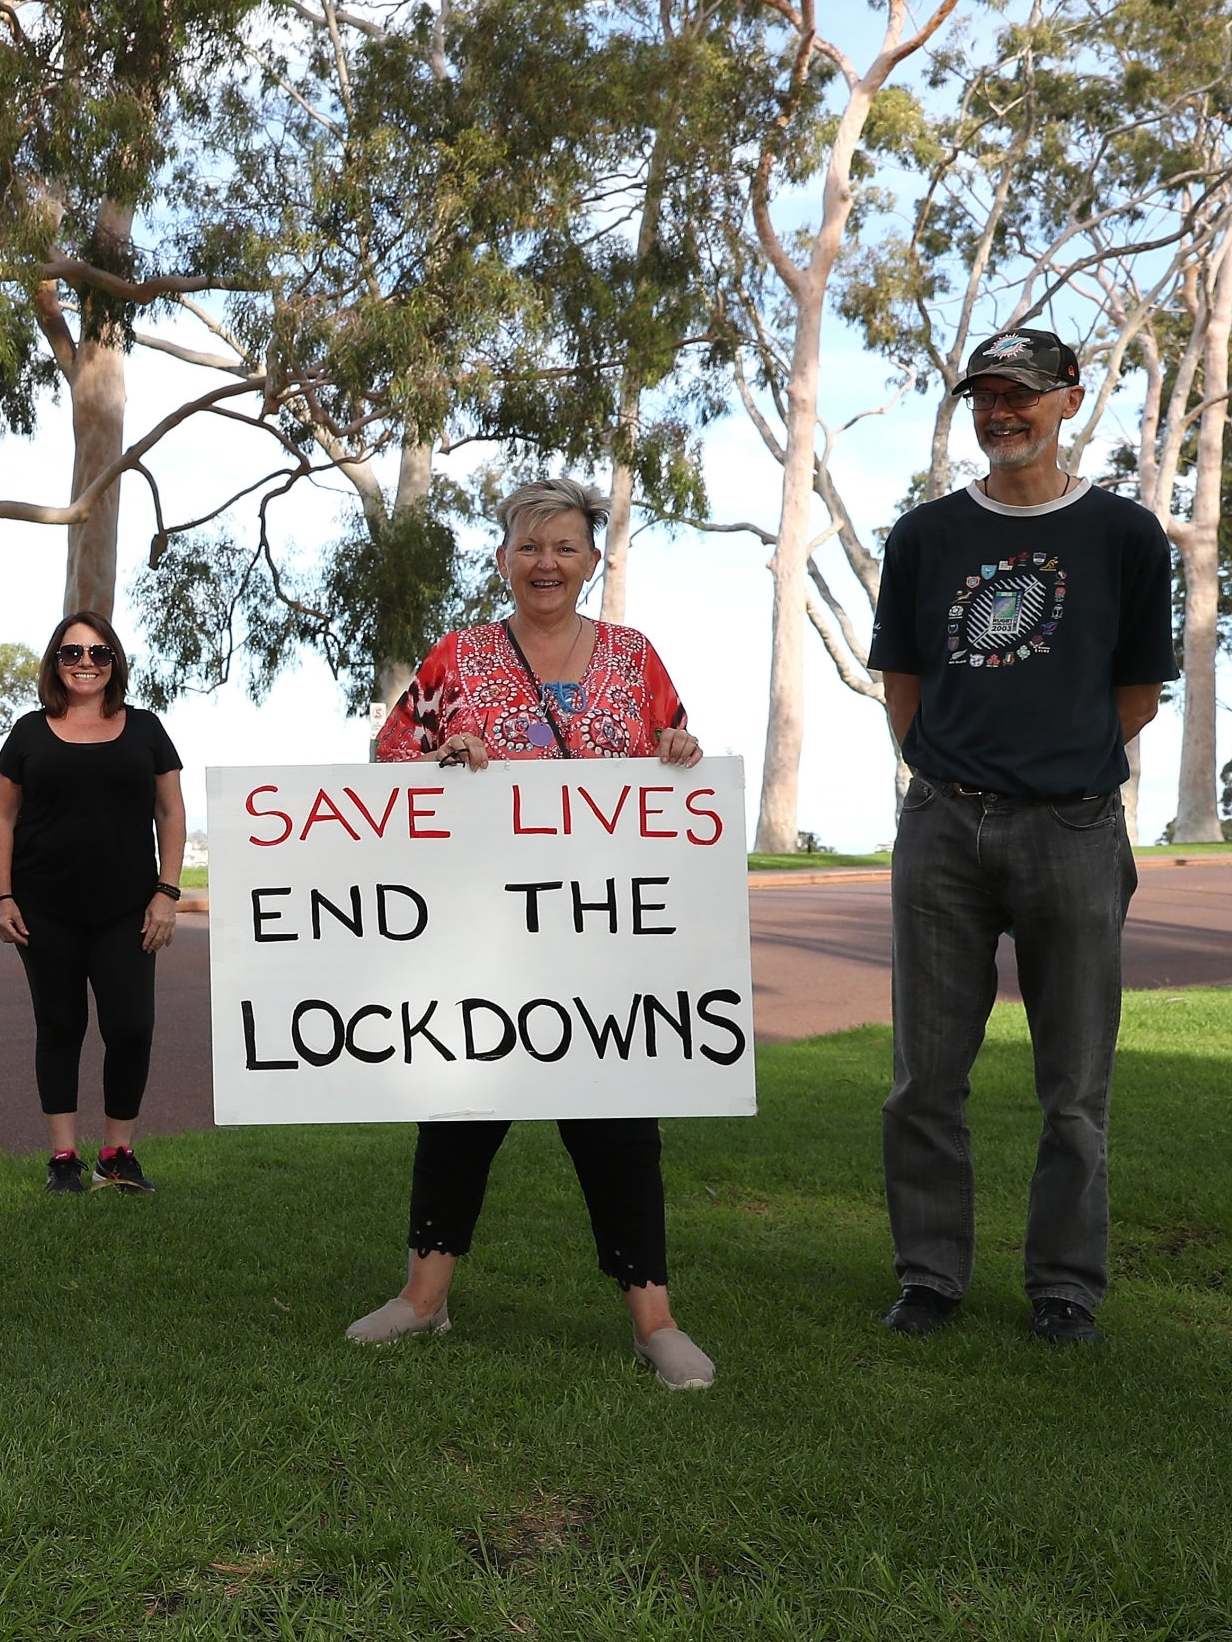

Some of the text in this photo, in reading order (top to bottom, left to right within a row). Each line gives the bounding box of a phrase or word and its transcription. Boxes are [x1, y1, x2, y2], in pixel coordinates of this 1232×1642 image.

[245, 785, 723, 847] SAVE LIVES
[251, 876, 677, 943] END THE
[241, 988, 746, 1071] LOCKDOWNS
